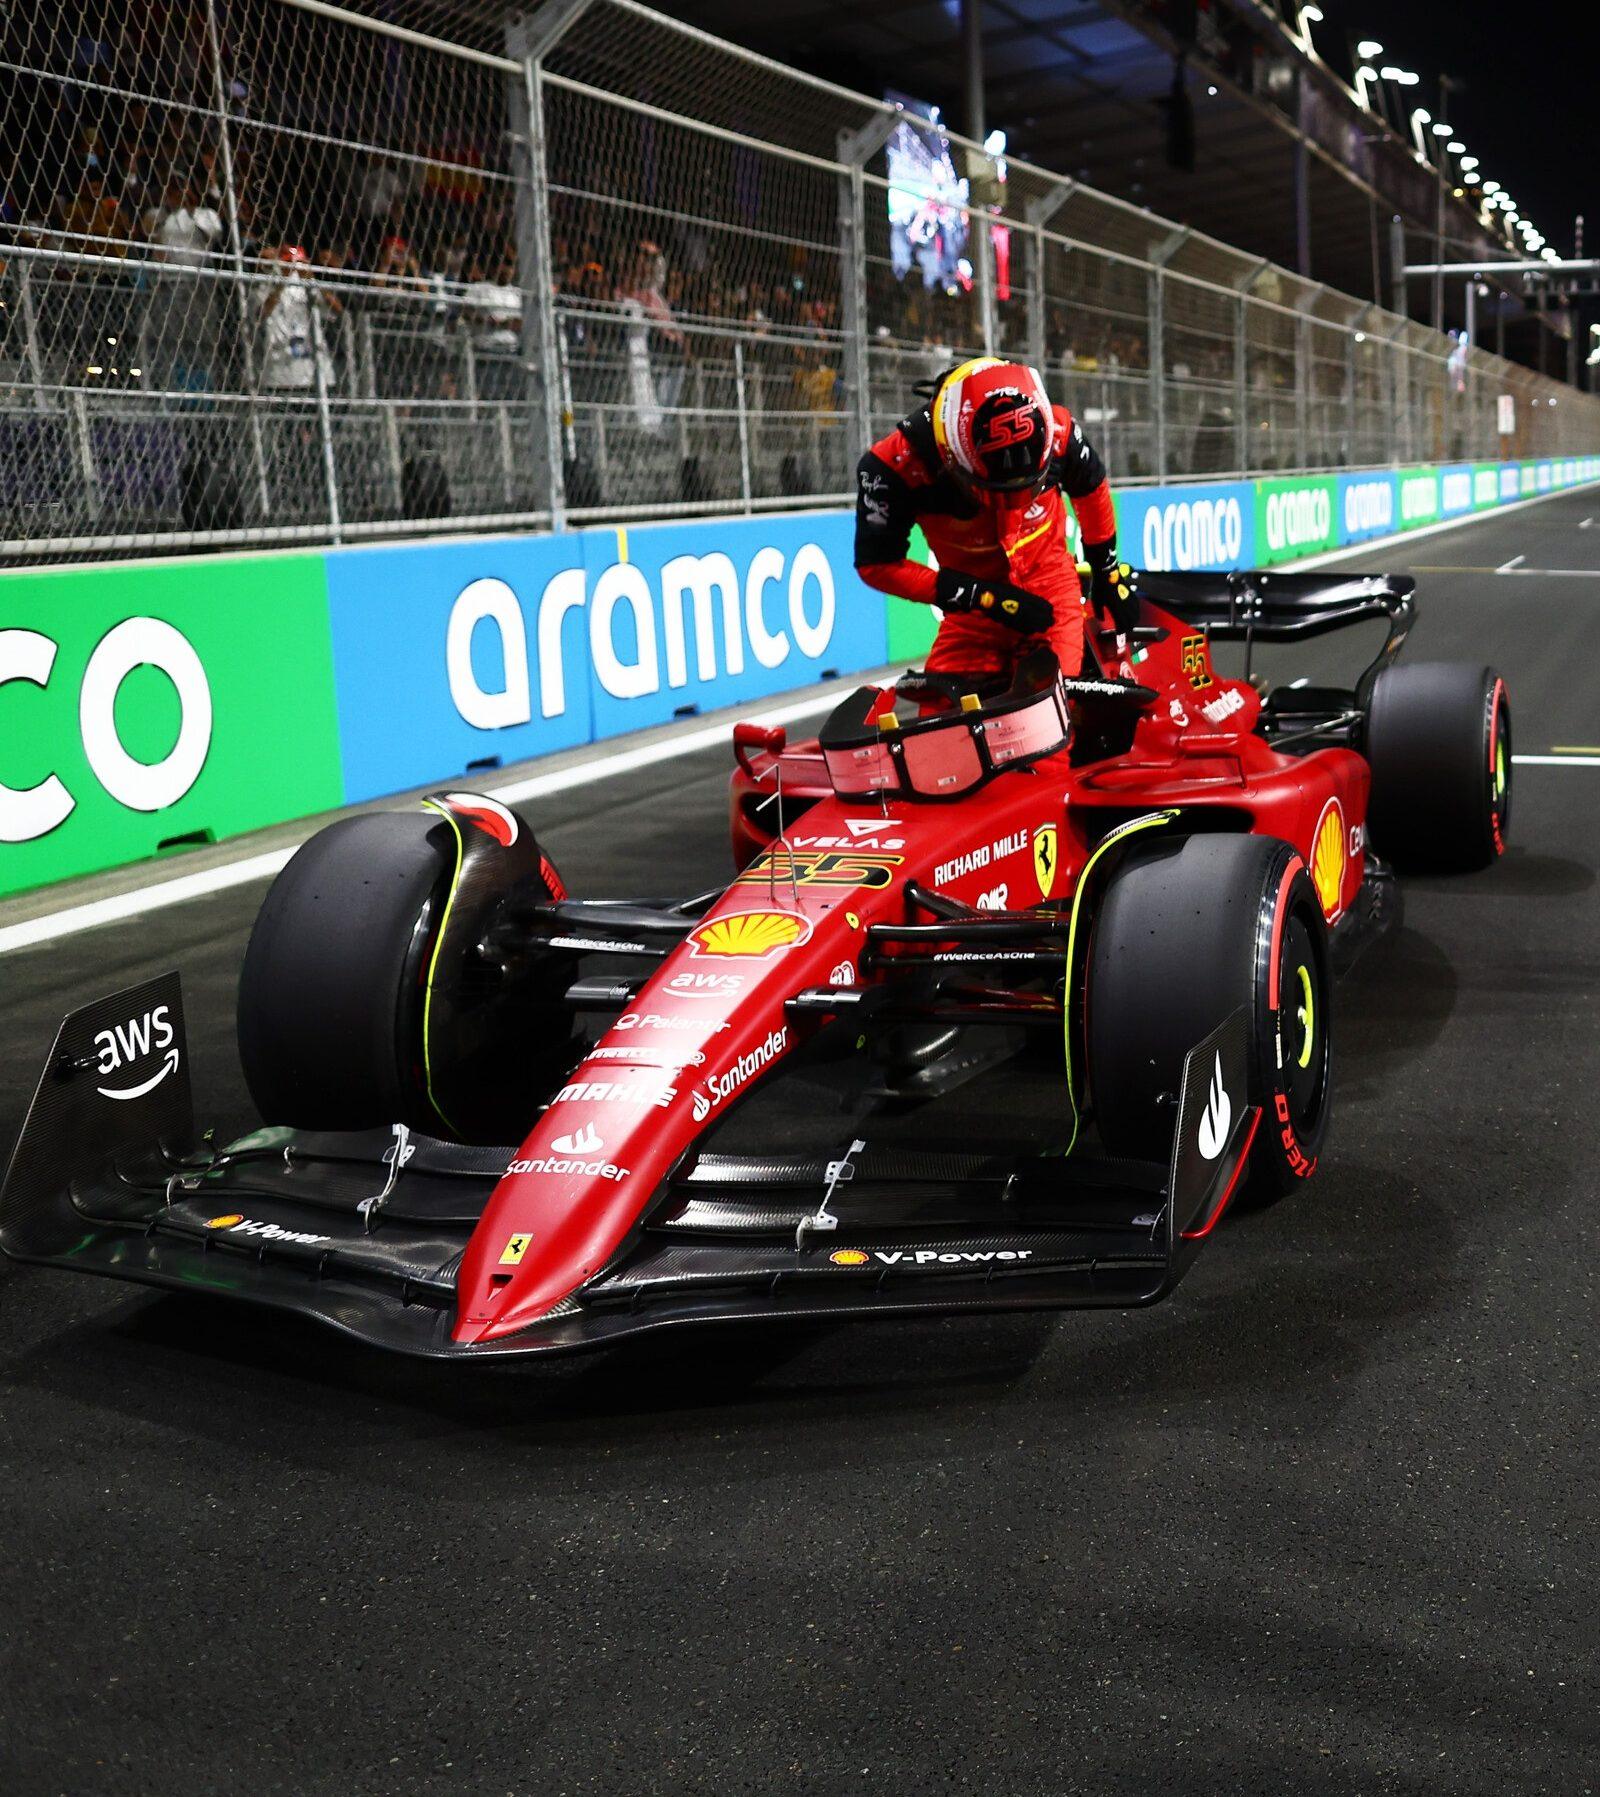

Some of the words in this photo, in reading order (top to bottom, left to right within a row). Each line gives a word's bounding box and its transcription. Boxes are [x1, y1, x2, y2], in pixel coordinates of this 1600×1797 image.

[1143, 497, 1242, 572] aramco
[1265, 488, 1331, 550] aramco
[446, 542, 836, 730] aramco
[1064, 678, 1126, 695] Snapdragon
[792, 835, 906, 851] VELAS
[934, 845, 990, 887] RICHARD
[993, 829, 1028, 861] MILLE
[736, 851, 906, 890] 55
[934, 952, 1035, 961] #WeRaceAsOne
[670, 972, 745, 988] aws
[94, 1005, 174, 1074] aws
[708, 1026, 788, 1107] Santander
[230, 1219, 331, 1246] V-Power
[876, 1247, 1033, 1265] V-Power
